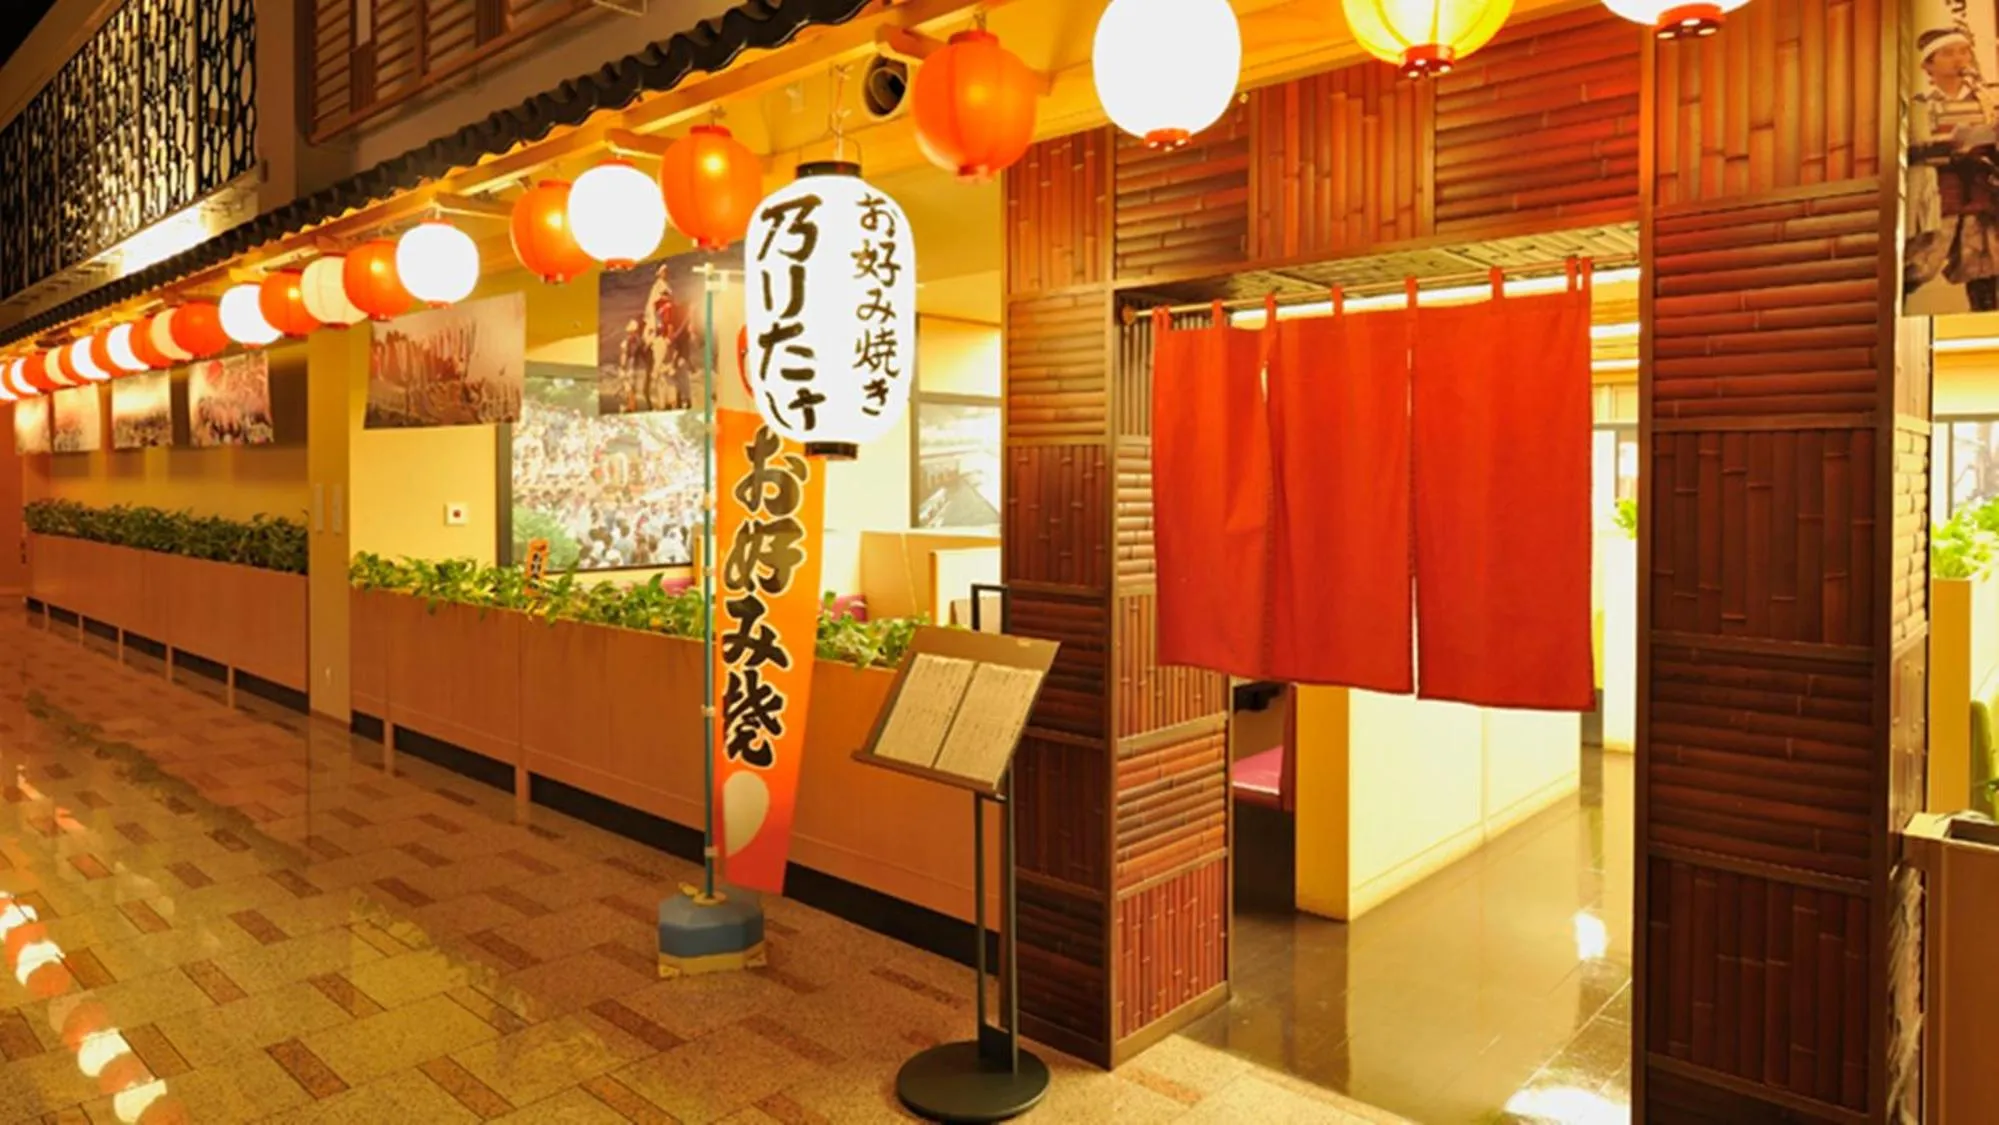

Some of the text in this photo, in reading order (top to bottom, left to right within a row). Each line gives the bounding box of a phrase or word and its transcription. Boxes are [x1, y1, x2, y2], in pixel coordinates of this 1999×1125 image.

[757, 194, 826, 431] 乃りたけ
[851, 193, 902, 416] お好み焼き
[723, 426, 808, 767] お好み焼
